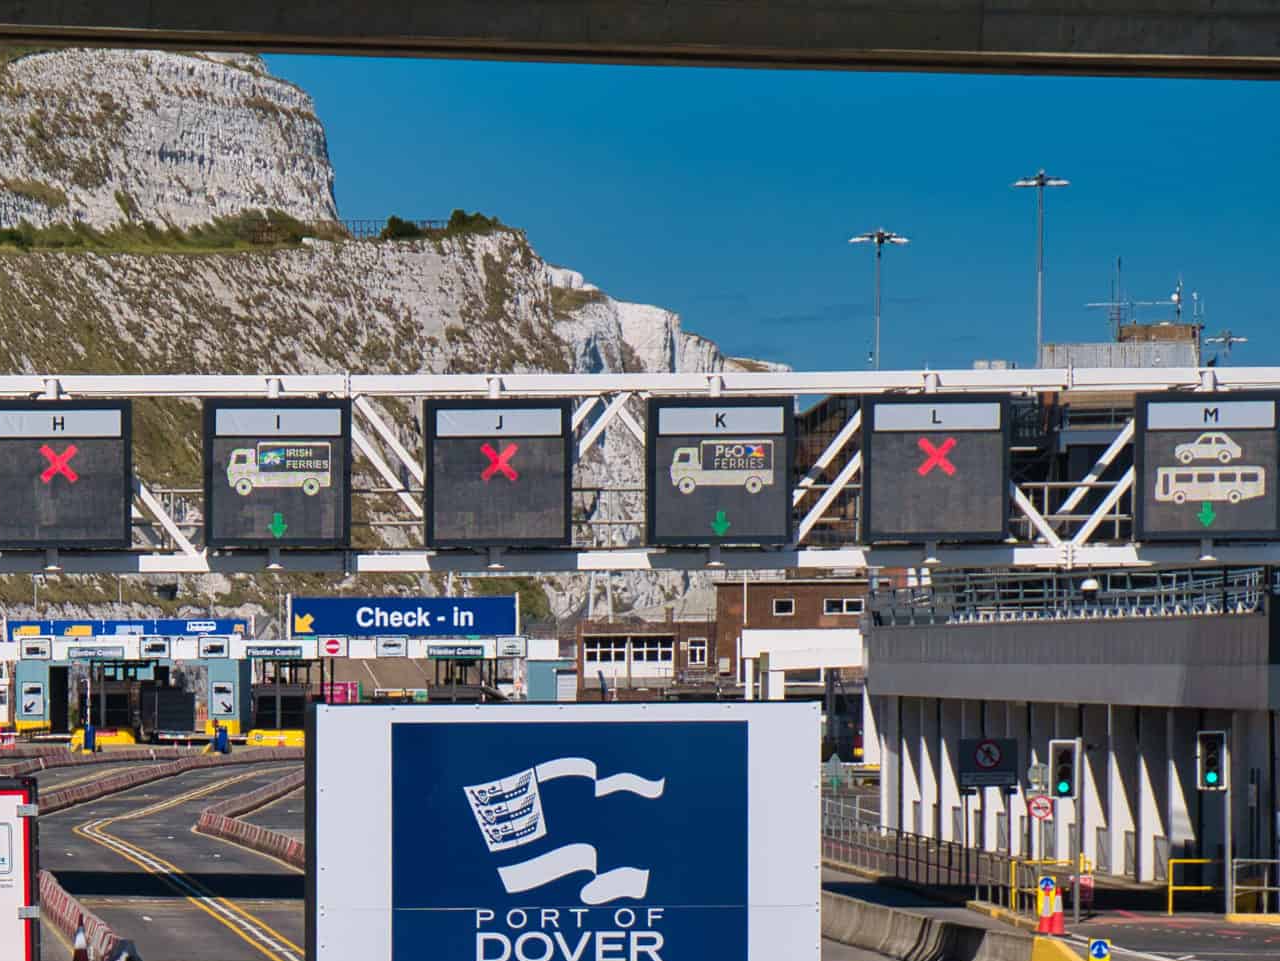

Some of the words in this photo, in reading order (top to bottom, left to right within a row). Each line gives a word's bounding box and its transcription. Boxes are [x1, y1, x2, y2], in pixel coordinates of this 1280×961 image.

[715, 413, 727, 428] K
[931, 410, 942, 424] L
[1204, 407, 1219, 422] M
[52, 416, 65, 431] H
[276, 415, 280, 430] I
[495, 415, 503, 430] J
[286, 448, 312, 457] IRISH
[715, 445, 744, 457] P&O
[286, 460, 328, 469] FERRIES
[714, 458, 764, 469] FERRIES
[356, 606, 430, 627] Check
[453, 606, 474, 627] in
[476, 908, 589, 928] PORT
[614, 908, 664, 928] OF
